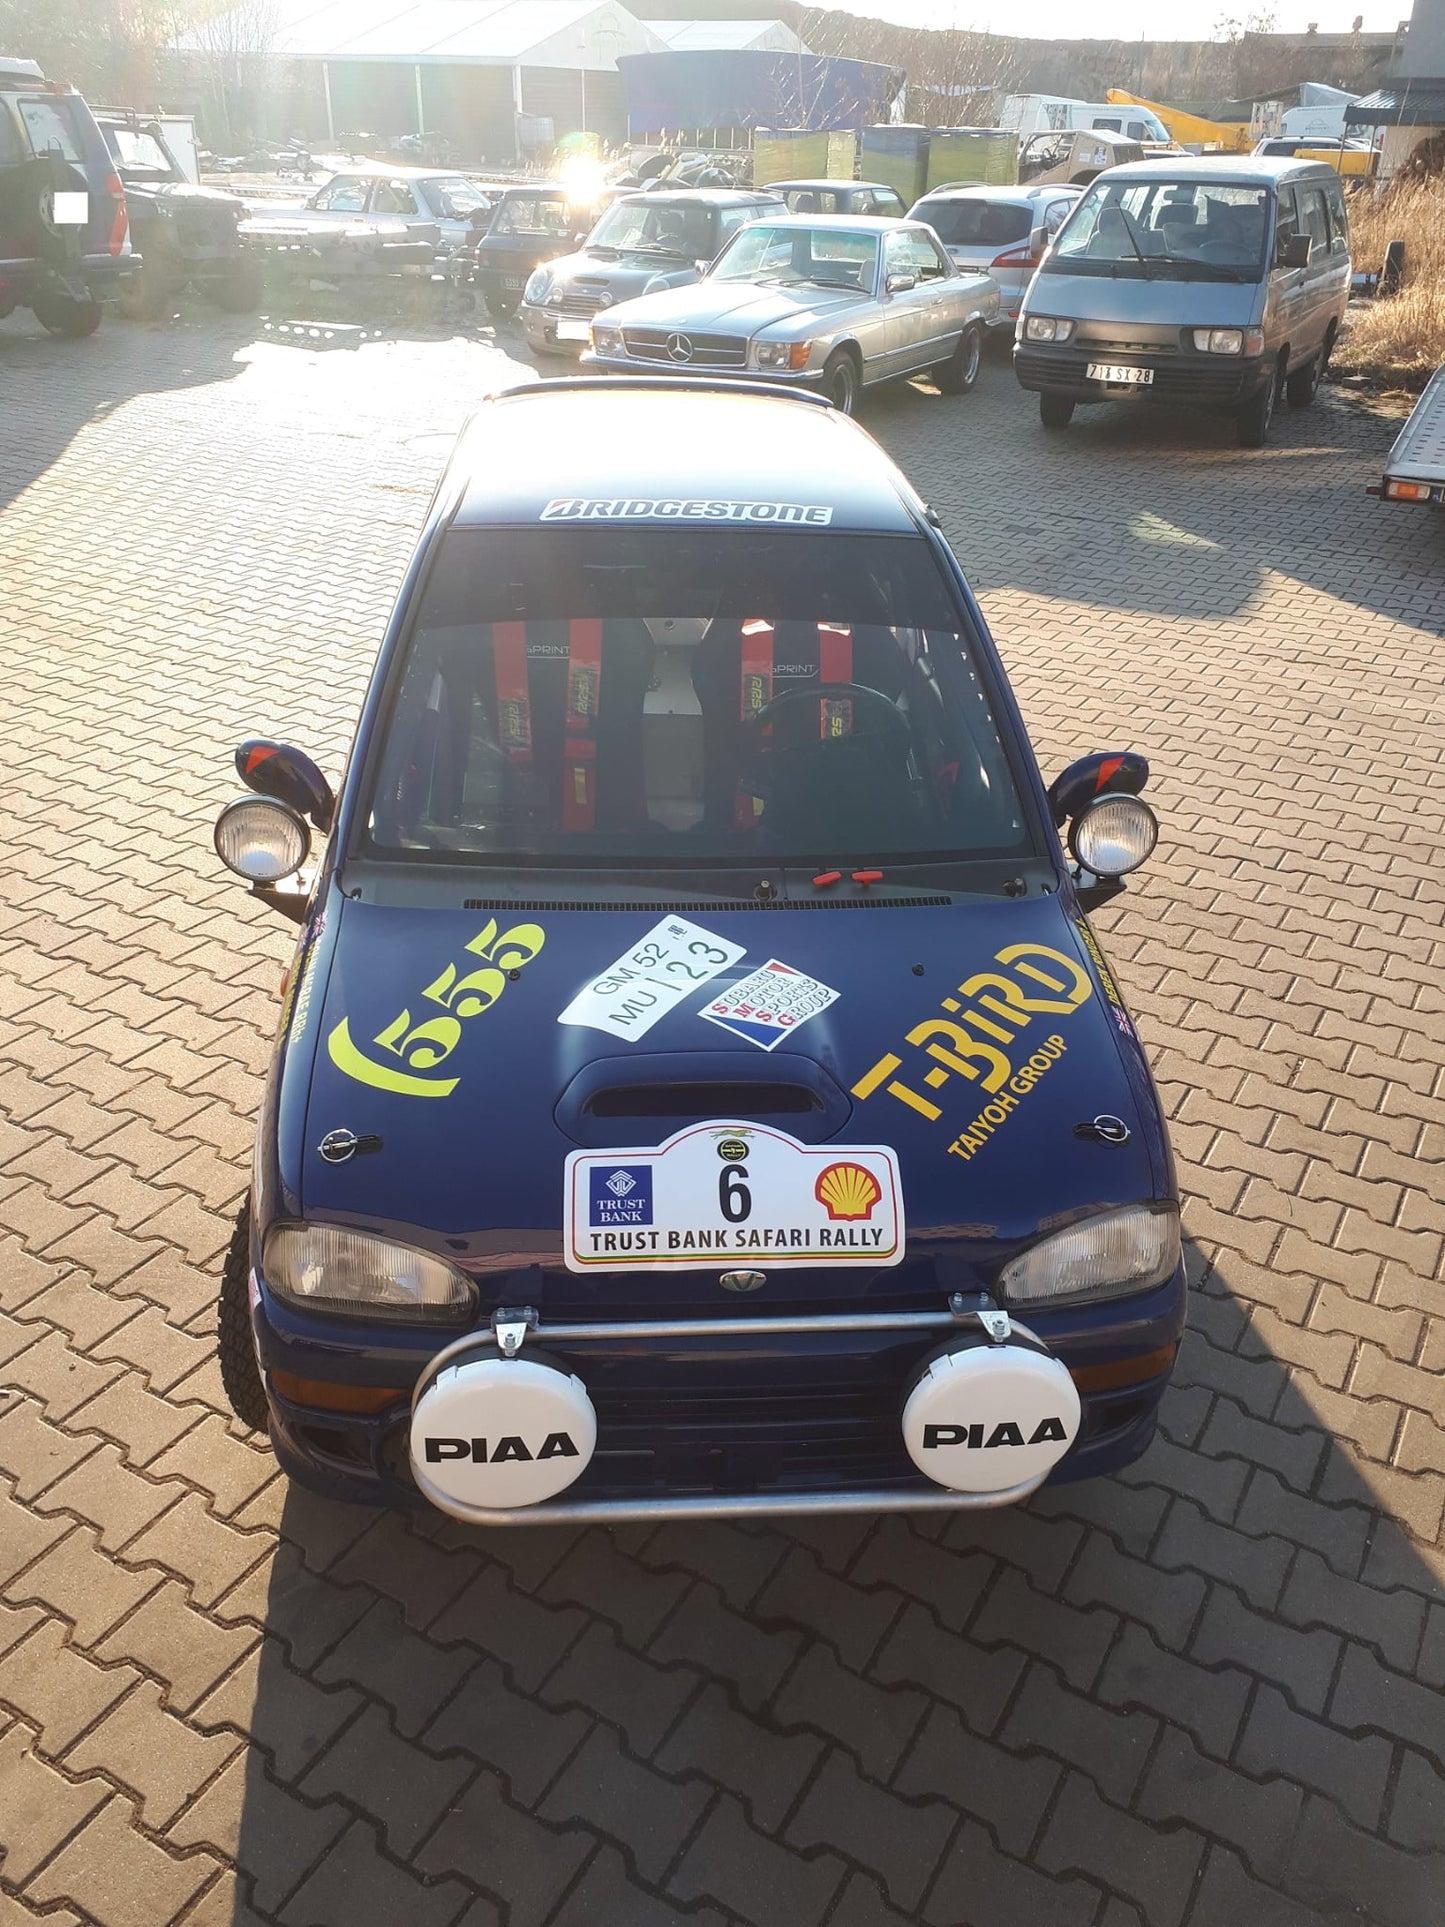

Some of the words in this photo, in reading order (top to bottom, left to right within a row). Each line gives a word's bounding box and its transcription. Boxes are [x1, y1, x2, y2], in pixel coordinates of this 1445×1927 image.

[1116, 368, 1131, 381] SX
[1136, 369, 1151, 383] 28
[545, 499, 828, 524] BRIDGESTONE
[593, 967, 641, 996] GM
[632, 943, 670, 968] 52
[372, 917, 546, 1069] 555
[608, 990, 658, 1025] MU
[711, 968, 776, 1014] SUBARU
[732, 977, 794, 1018] MOTOR
[755, 978, 818, 1022] SPORTS
[777, 988, 832, 1027] GROUP
[947, 1091, 1020, 1161] TAIYOH
[1009, 1034, 1068, 1095] GROUP
[596, 1199, 646, 1211] TRUST
[719, 1164, 752, 1224] 6
[600, 1211, 642, 1222] BANK
[590, 1232, 660, 1251] TRUST
[668, 1230, 728, 1249] BANK
[735, 1229, 810, 1247] SAFARI
[819, 1228, 883, 1246] RALLY
[424, 1431, 580, 1463] PIAA
[923, 1417, 1068, 1449] PIAA
